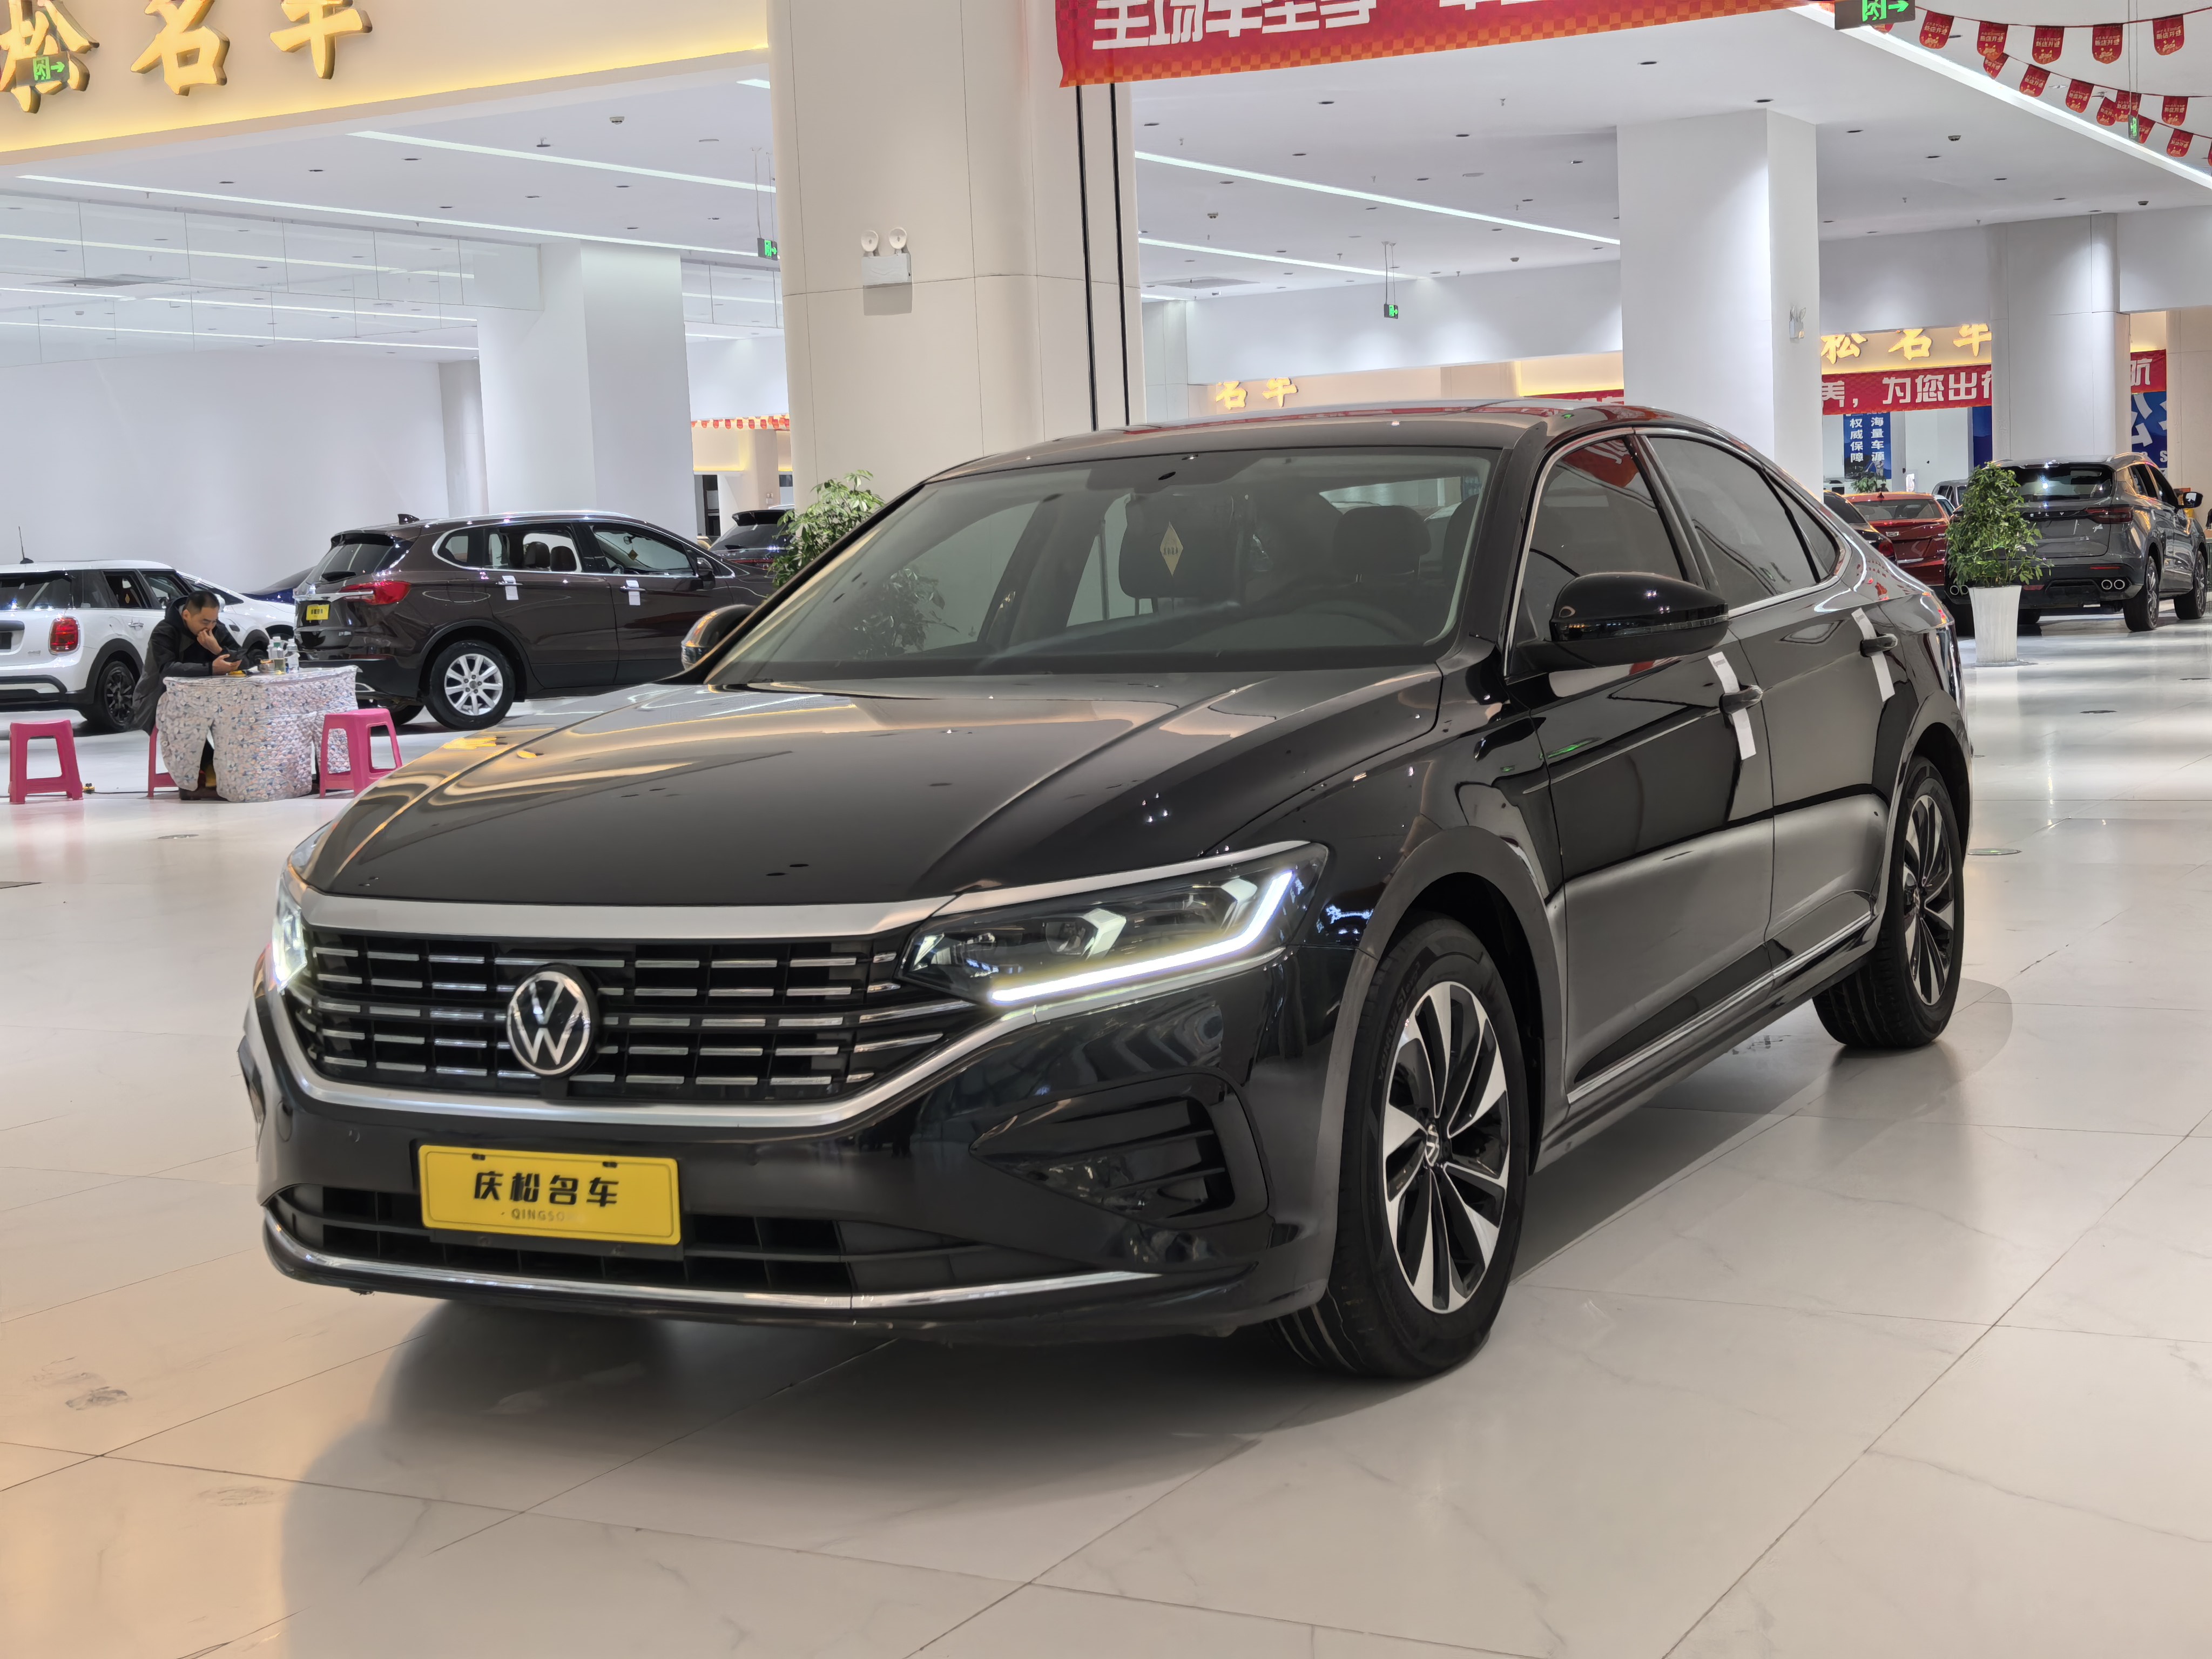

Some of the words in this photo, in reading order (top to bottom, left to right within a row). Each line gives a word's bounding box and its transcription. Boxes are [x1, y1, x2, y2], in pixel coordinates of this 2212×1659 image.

[1850, 418, 1864, 463] 权威保障
[1871, 417, 1885, 462] 海量车源
[474, 1170, 619, 1208] 庆松名车
